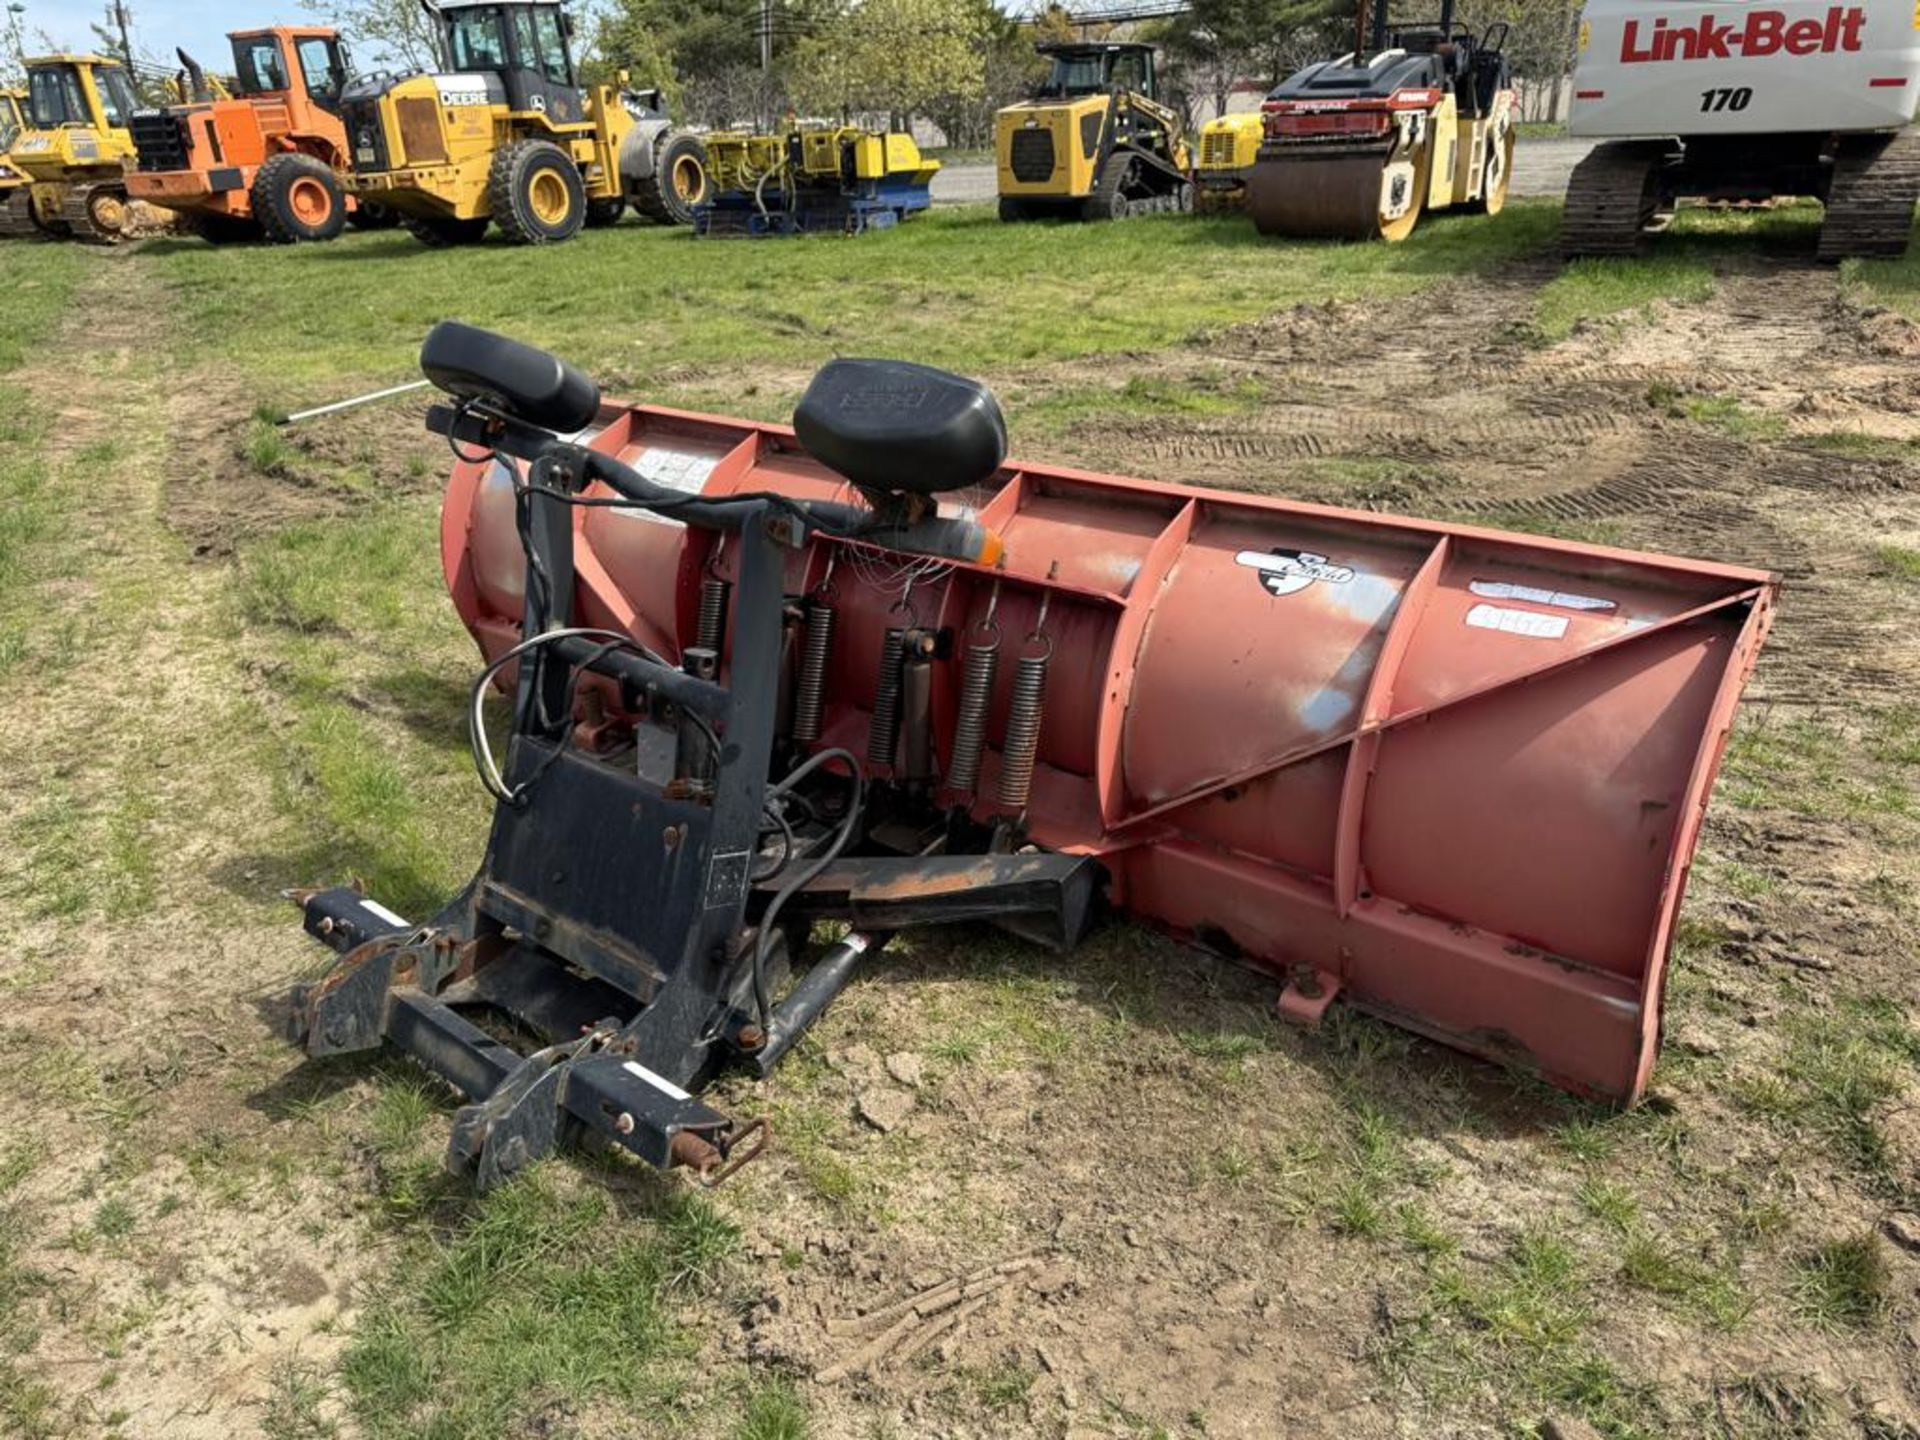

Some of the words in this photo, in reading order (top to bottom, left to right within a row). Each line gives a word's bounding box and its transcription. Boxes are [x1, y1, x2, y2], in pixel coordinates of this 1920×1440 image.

[1620, 7, 1867, 63] Link-Belt
[440, 90, 489, 106] DEERE
[1700, 87, 1754, 112] 170
